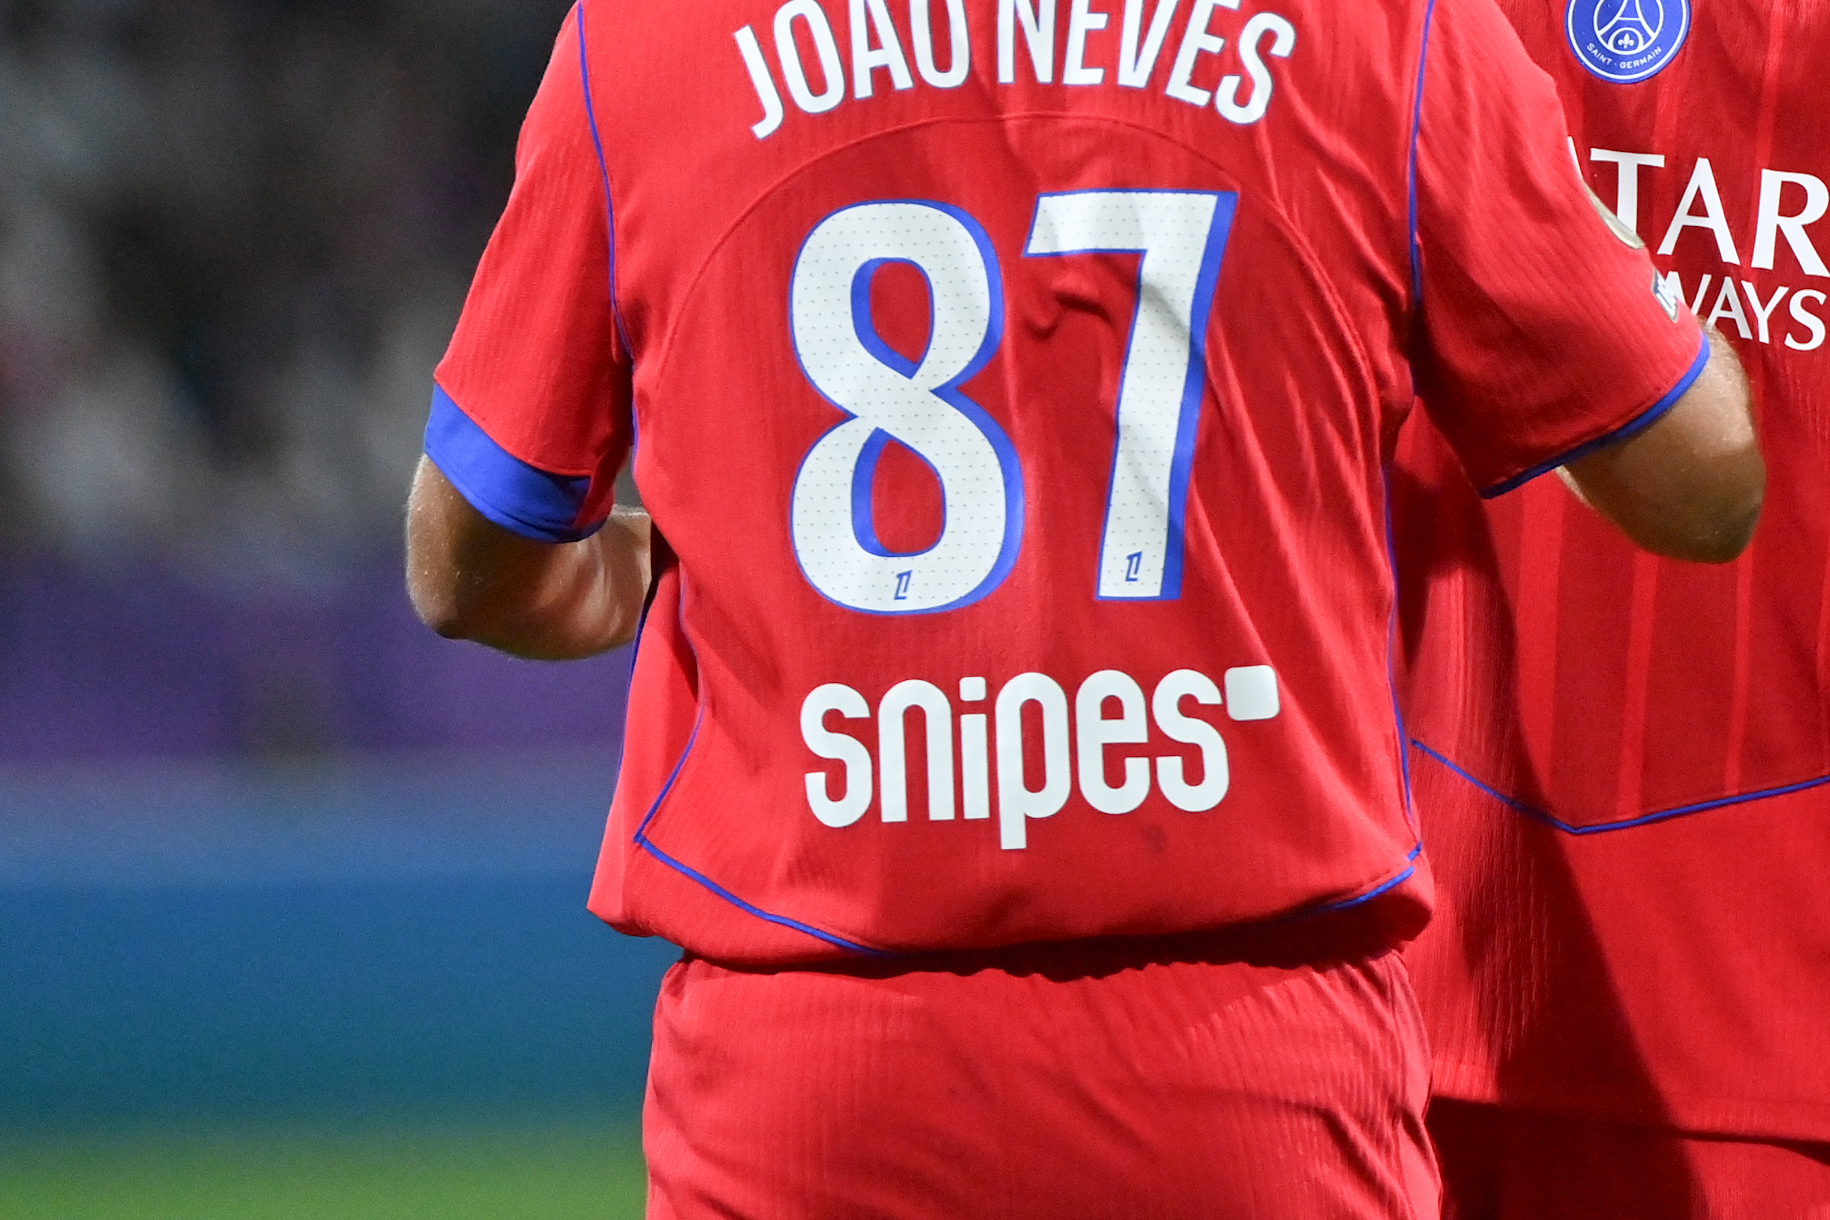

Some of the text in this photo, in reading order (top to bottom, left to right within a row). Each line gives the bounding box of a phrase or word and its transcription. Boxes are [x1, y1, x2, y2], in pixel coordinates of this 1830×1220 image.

[1586, 42, 1662, 69] SAINT GERMAIN
[788, 187, 1239, 616] 87
[799, 668, 1231, 850] snipes
